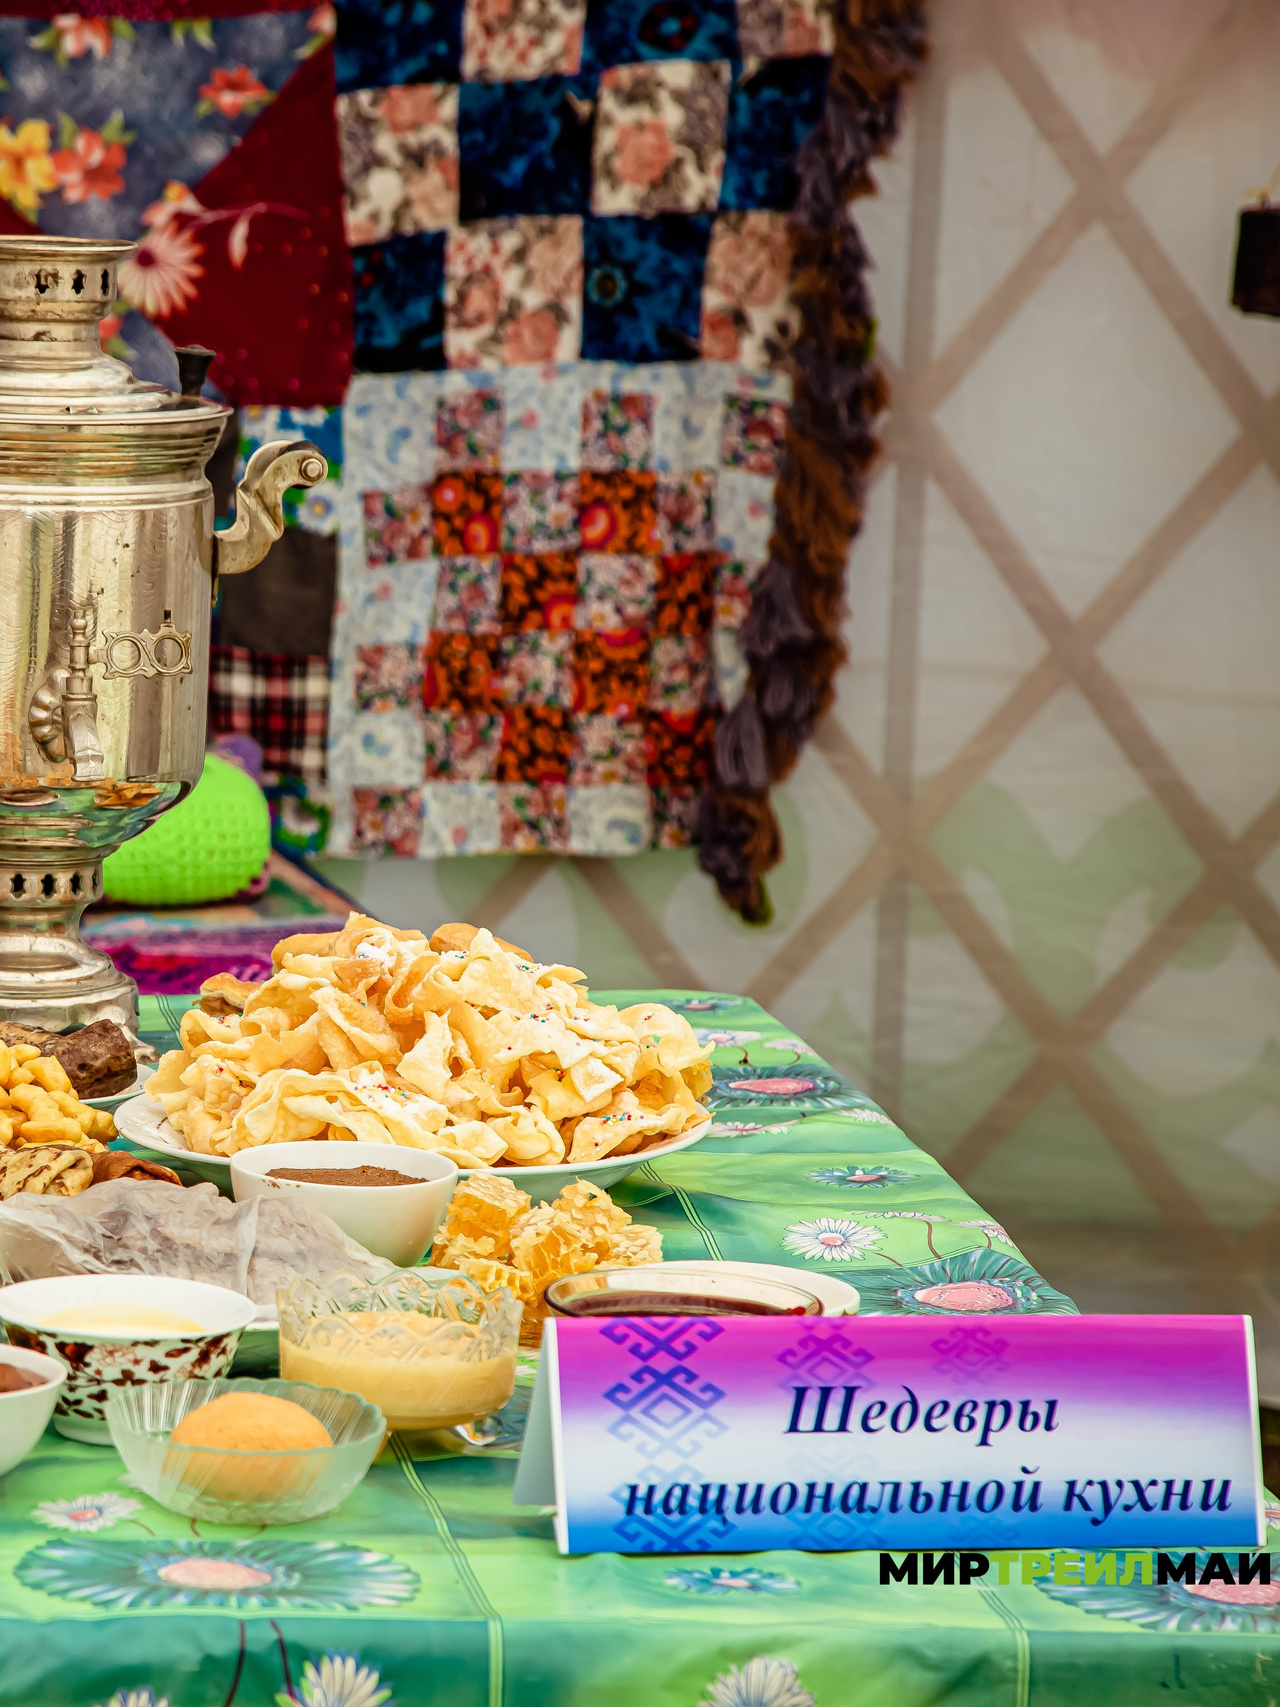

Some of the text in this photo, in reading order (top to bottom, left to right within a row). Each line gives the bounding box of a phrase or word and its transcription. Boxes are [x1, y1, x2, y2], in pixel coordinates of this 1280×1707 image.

[783, 1384, 1060, 1447] Шедевры
[624, 1464, 1234, 1527] национальной кухни
